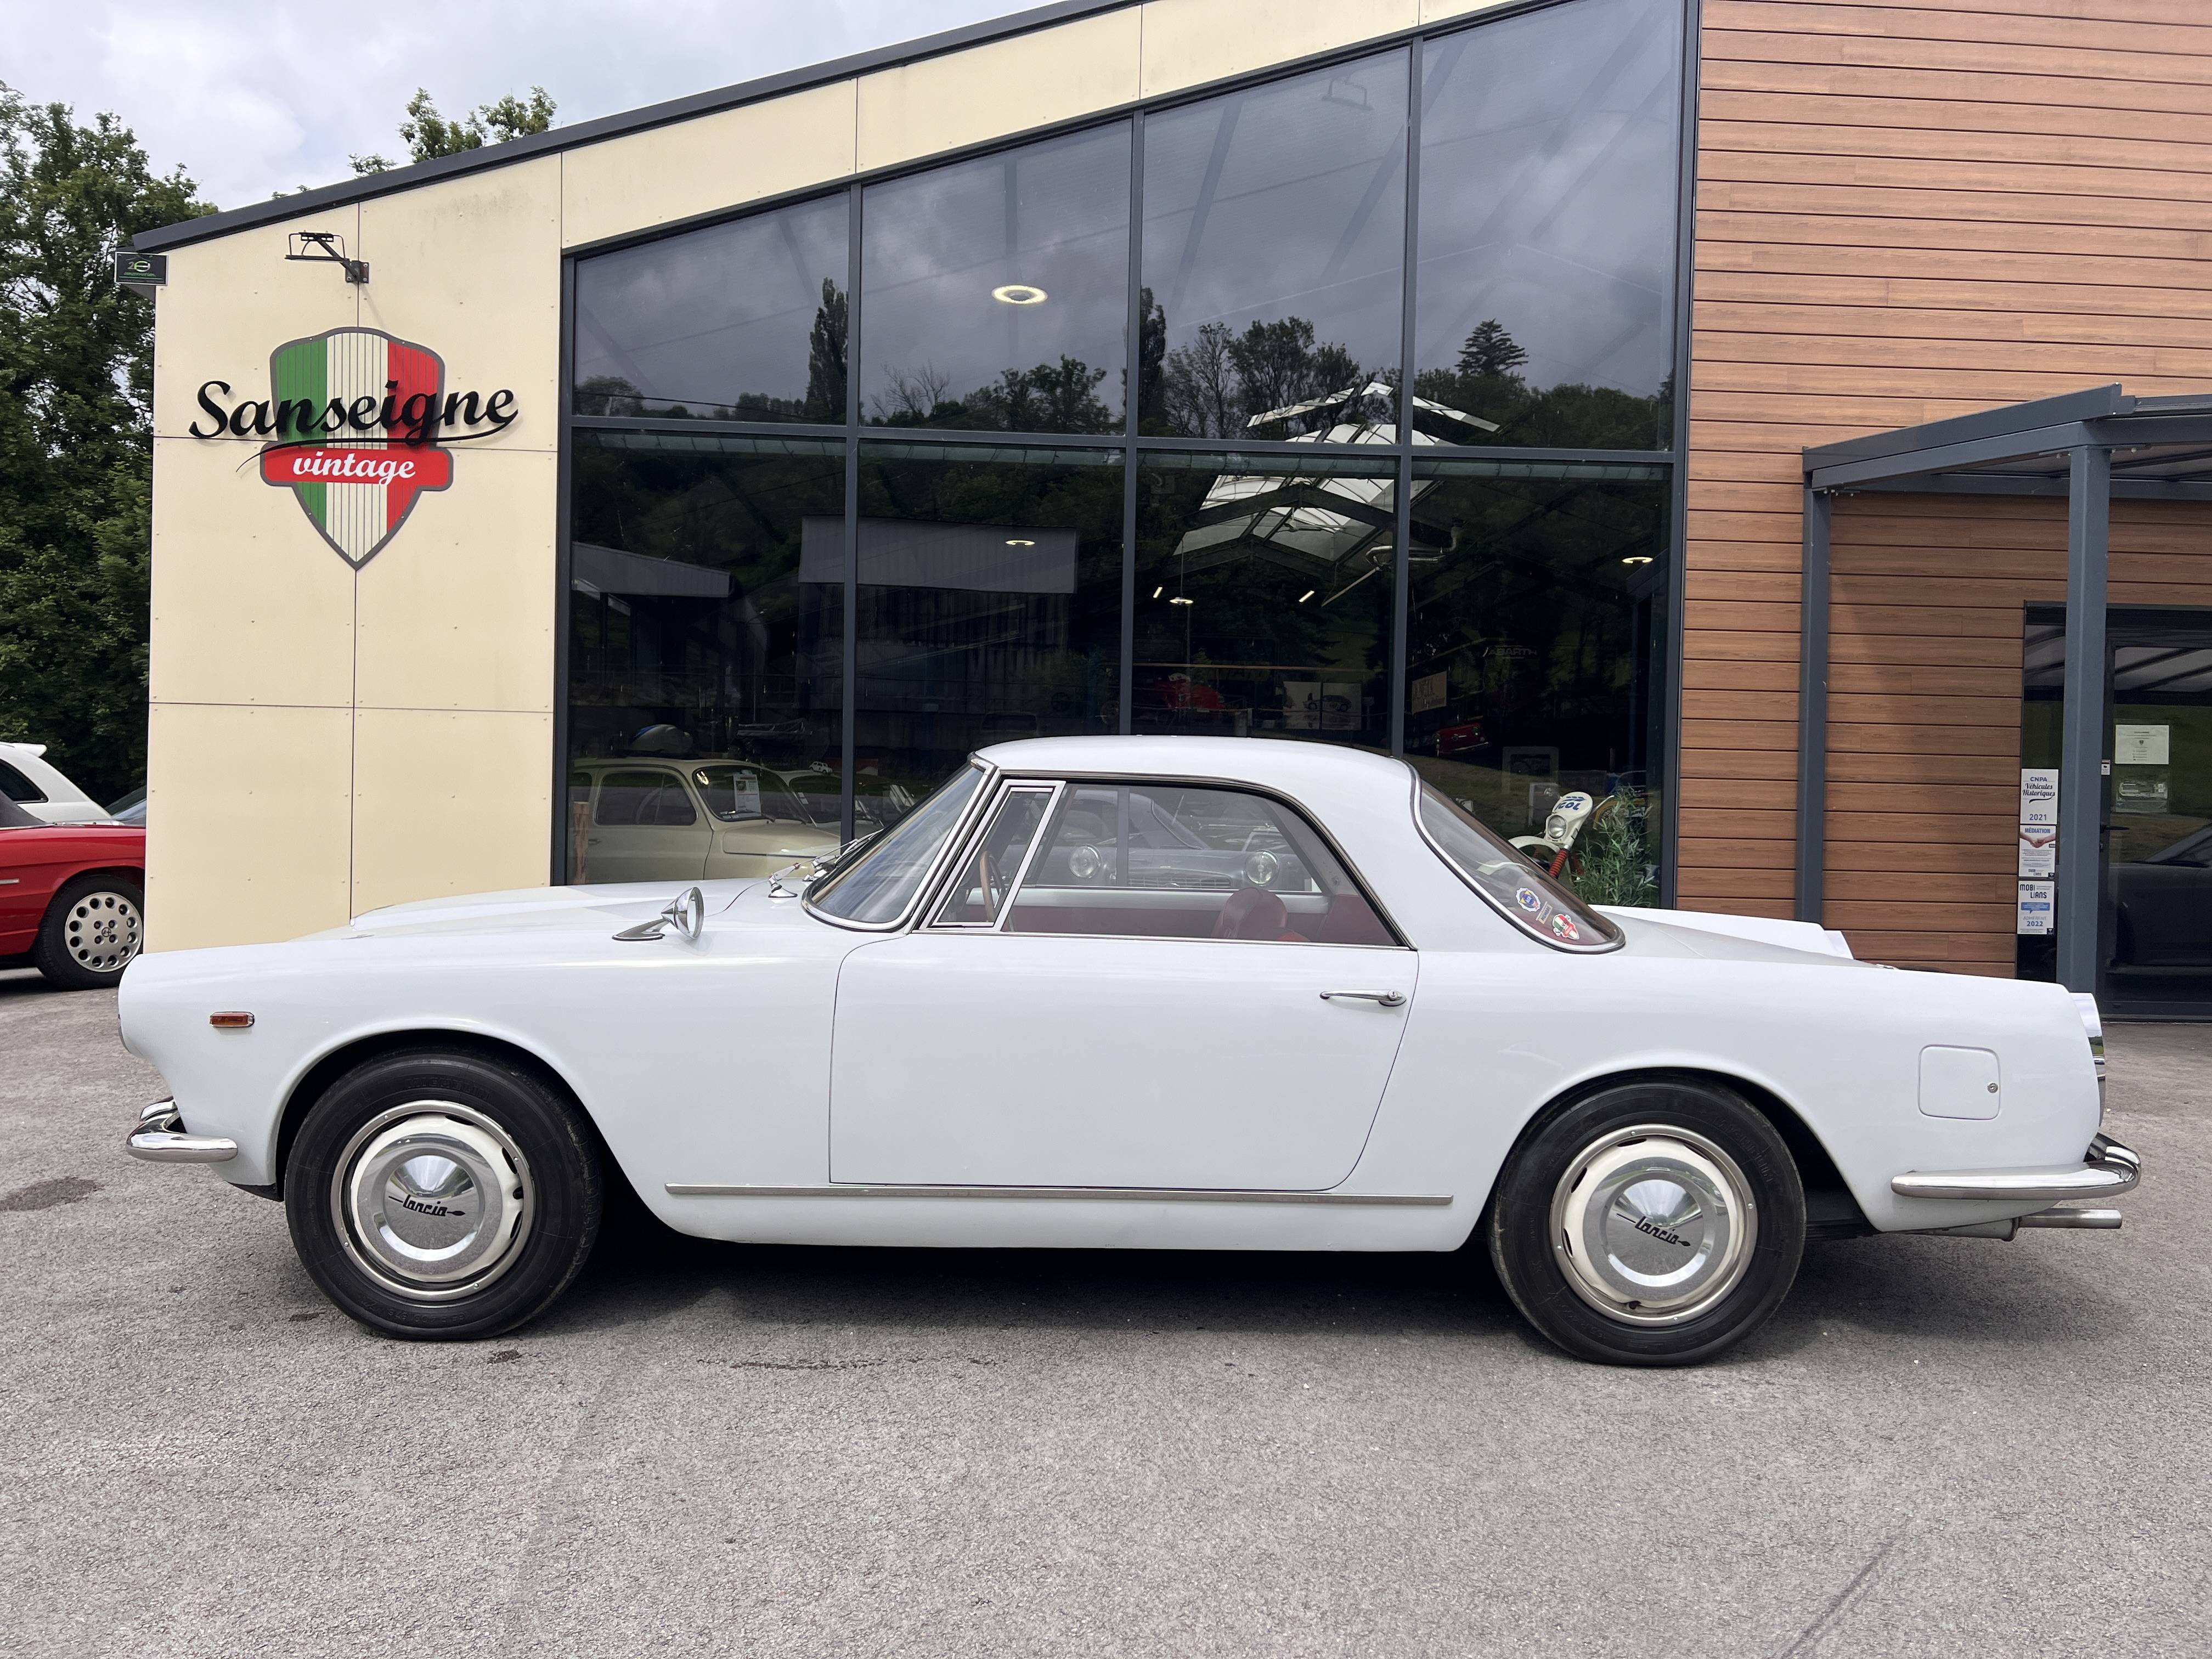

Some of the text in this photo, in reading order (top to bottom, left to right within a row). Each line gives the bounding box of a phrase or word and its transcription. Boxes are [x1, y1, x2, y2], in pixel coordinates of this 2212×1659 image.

[189, 380, 518, 445] Sanseigne
[292, 451, 416, 486] vintage
[2022, 789, 2055, 798] Historiques
